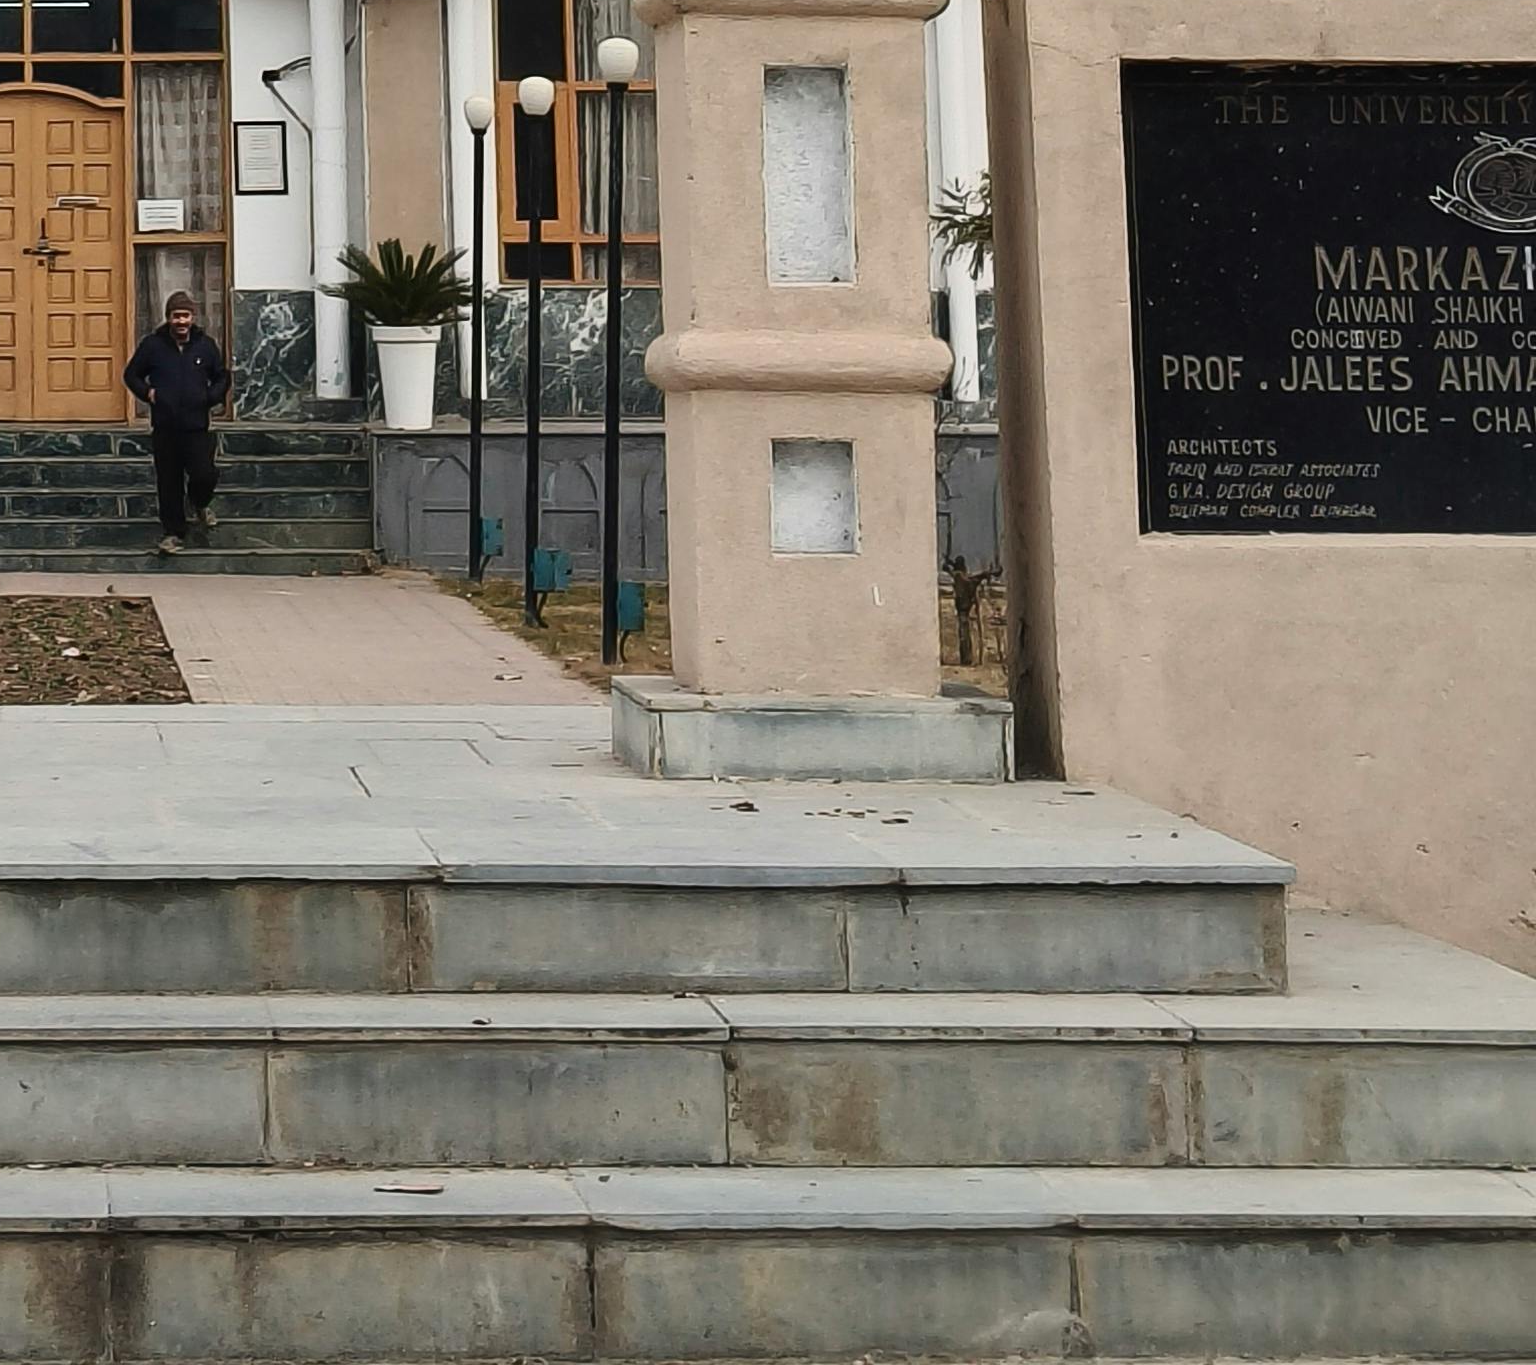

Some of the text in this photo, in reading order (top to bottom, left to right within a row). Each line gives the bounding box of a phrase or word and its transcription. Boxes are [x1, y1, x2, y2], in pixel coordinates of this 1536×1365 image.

[1216, 93, 1530, 125] THE UNIVERSITY
[1315, 296, 1524, 325] (AIWANI SHAIKH
[1434, 329, 1478, 349] AND
[1280, 355, 1413, 391] JALEES
[1167, 439, 1278, 456] ARCHITECTS
[1216, 482, 1274, 500] DESIGN
[1283, 482, 1335, 500] GROUP
